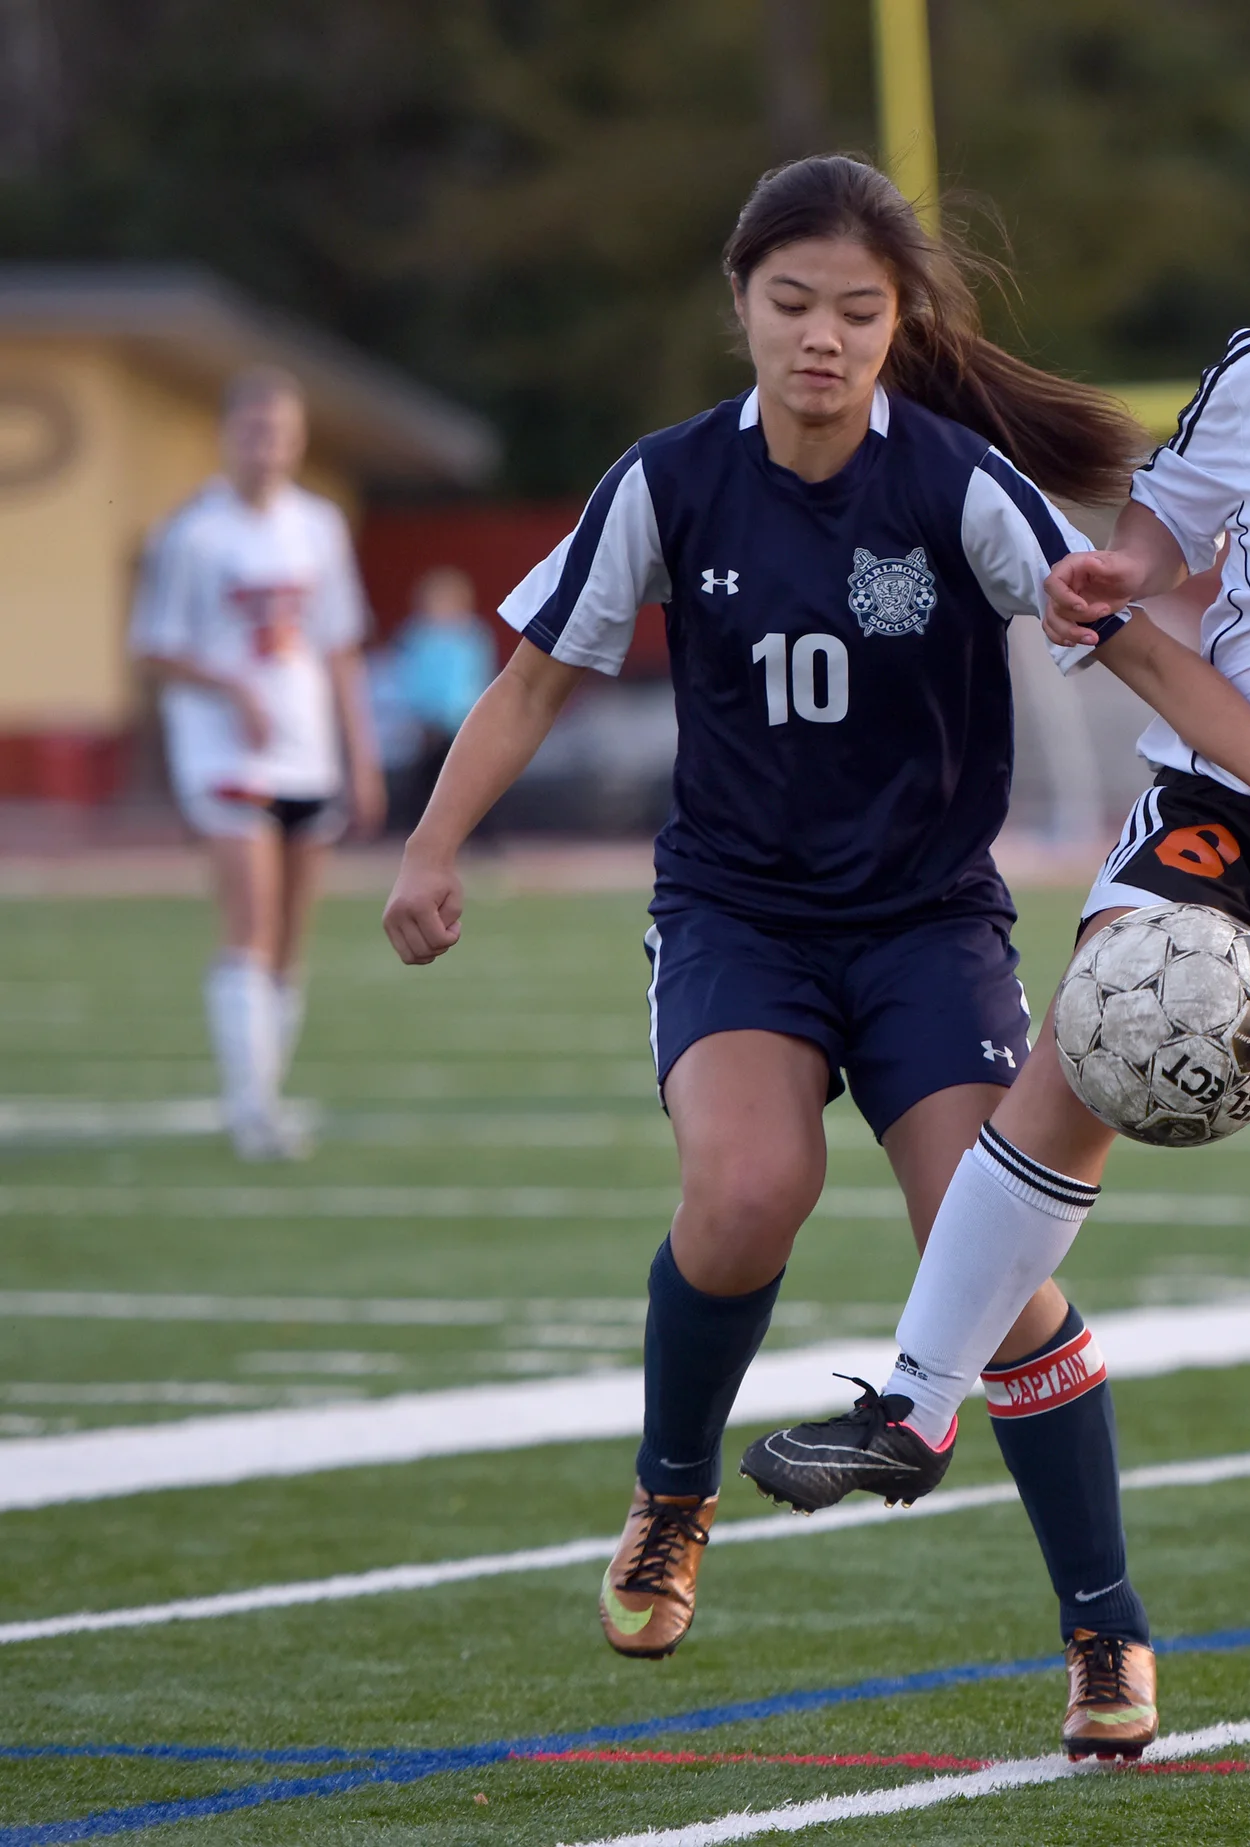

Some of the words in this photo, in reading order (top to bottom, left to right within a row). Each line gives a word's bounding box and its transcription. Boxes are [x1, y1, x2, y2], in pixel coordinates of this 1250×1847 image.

[856, 564, 929, 588] CARLMONT
[868, 613, 921, 632] SOCCER
[752, 633, 849, 726] 10
[1155, 824, 1241, 879] 6
[1004, 1350, 1090, 1406] CAPTAIN
